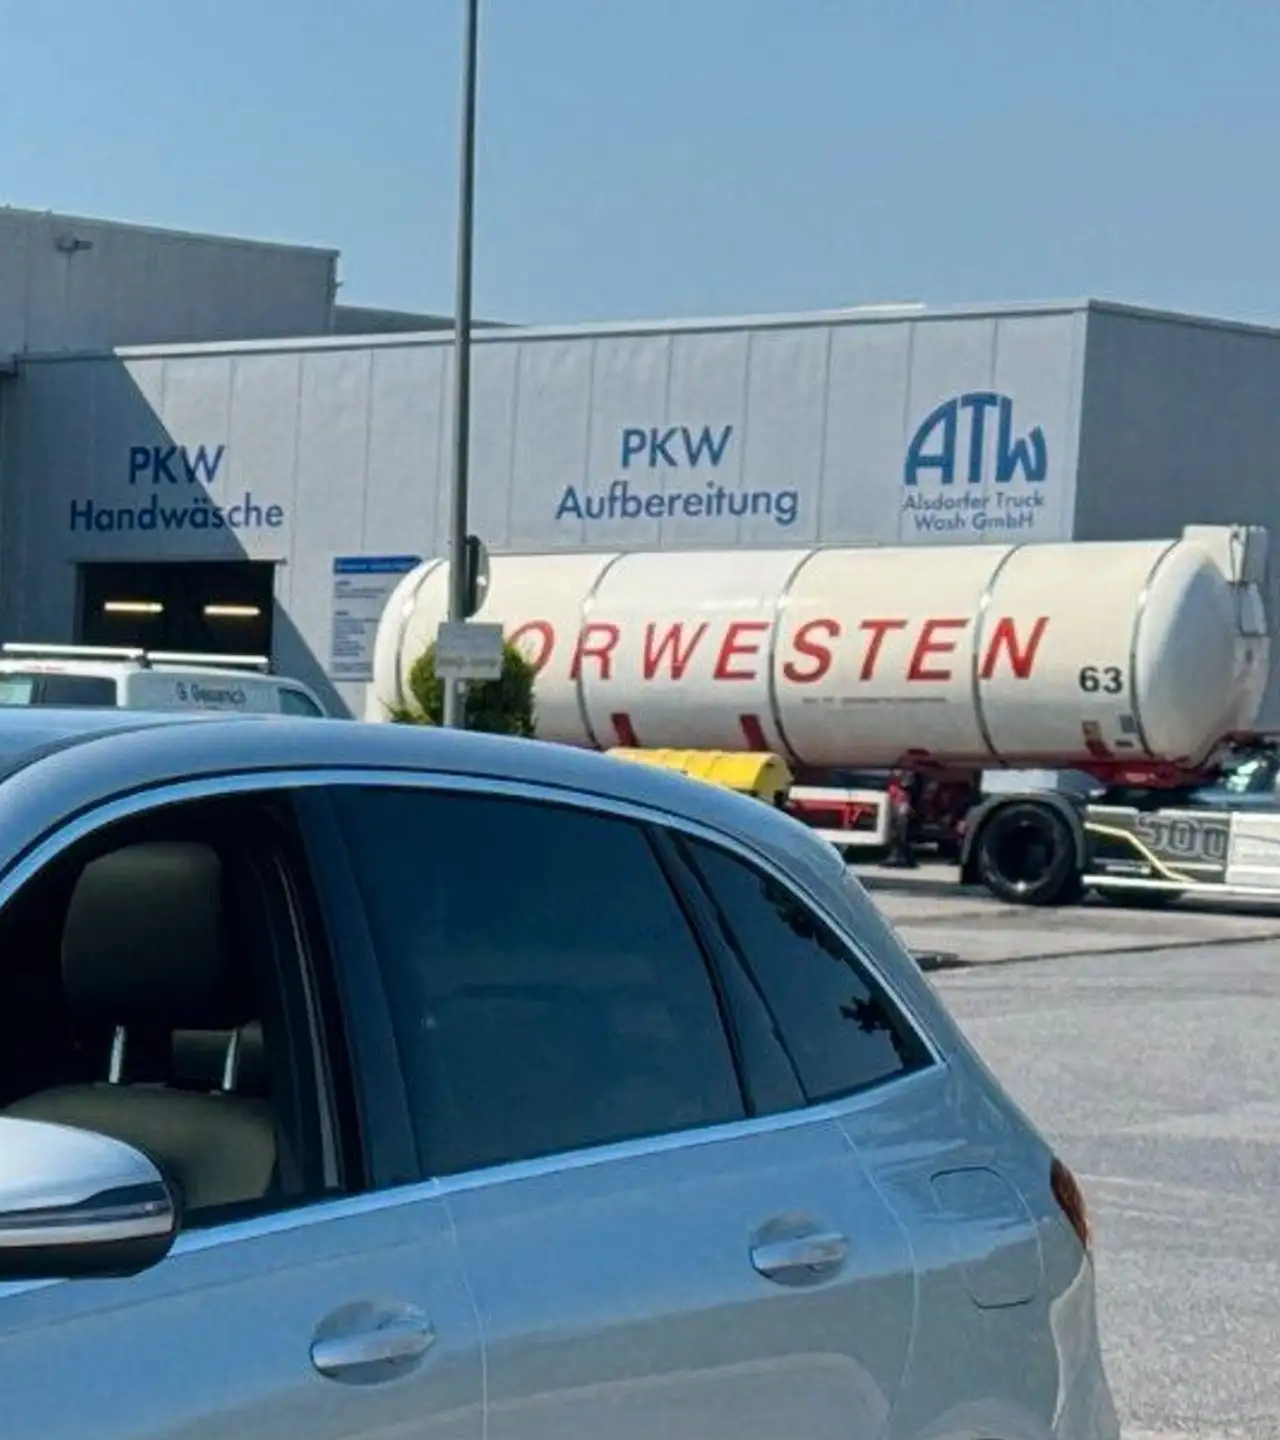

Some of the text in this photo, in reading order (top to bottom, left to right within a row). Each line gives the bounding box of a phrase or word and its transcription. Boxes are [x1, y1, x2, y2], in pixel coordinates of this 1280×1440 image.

[621, 425, 733, 469] PKW
[904, 391, 1048, 486] ATW
[128, 444, 226, 485] PKW
[70, 492, 284, 532] Handwäsche
[555, 480, 799, 526] Aufbereitung
[903, 490, 1044, 511] Alsdorfer Truck
[914, 511, 1034, 532] Wash GmbH
[504, 615, 1050, 684] ORWESTEN
[1078, 665, 1124, 694] 63
